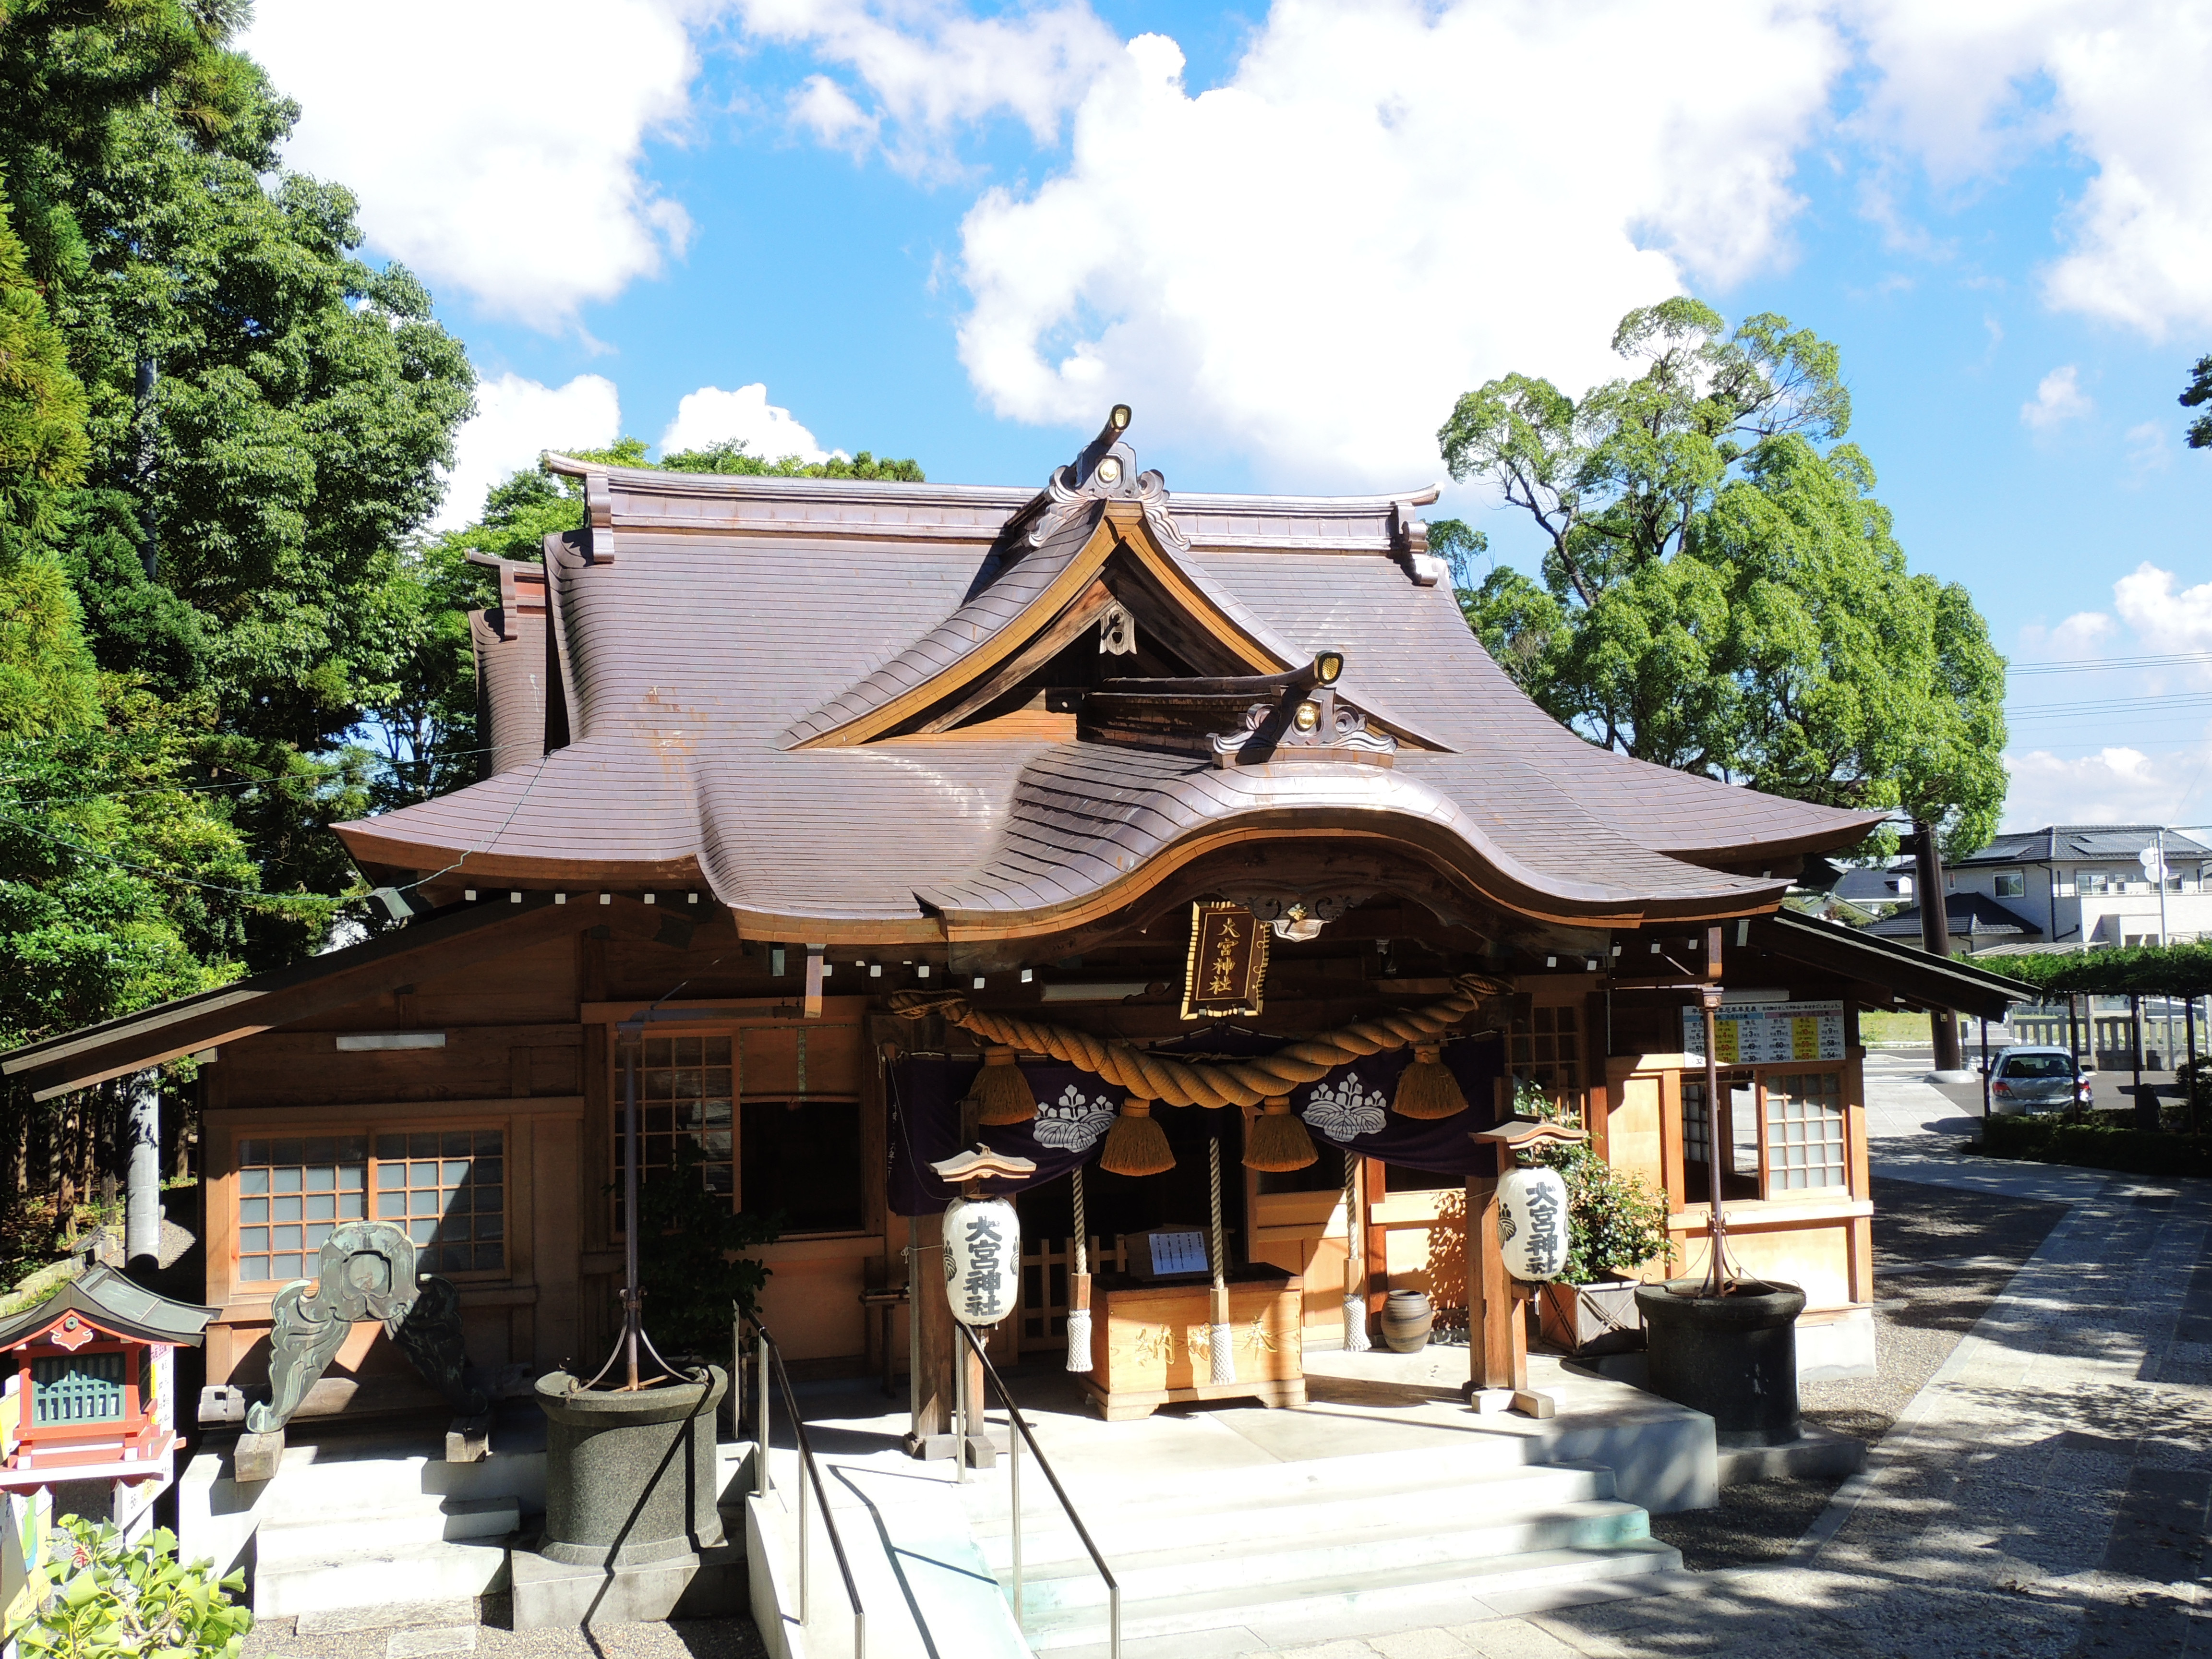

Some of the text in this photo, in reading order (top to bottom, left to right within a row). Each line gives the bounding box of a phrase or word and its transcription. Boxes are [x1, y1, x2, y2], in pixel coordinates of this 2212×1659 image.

[1206, 917, 1241, 995] 大宮神社
[963, 1215, 1003, 1317] 大宮神社
[1524, 1181, 1559, 1274] 大宮神社
